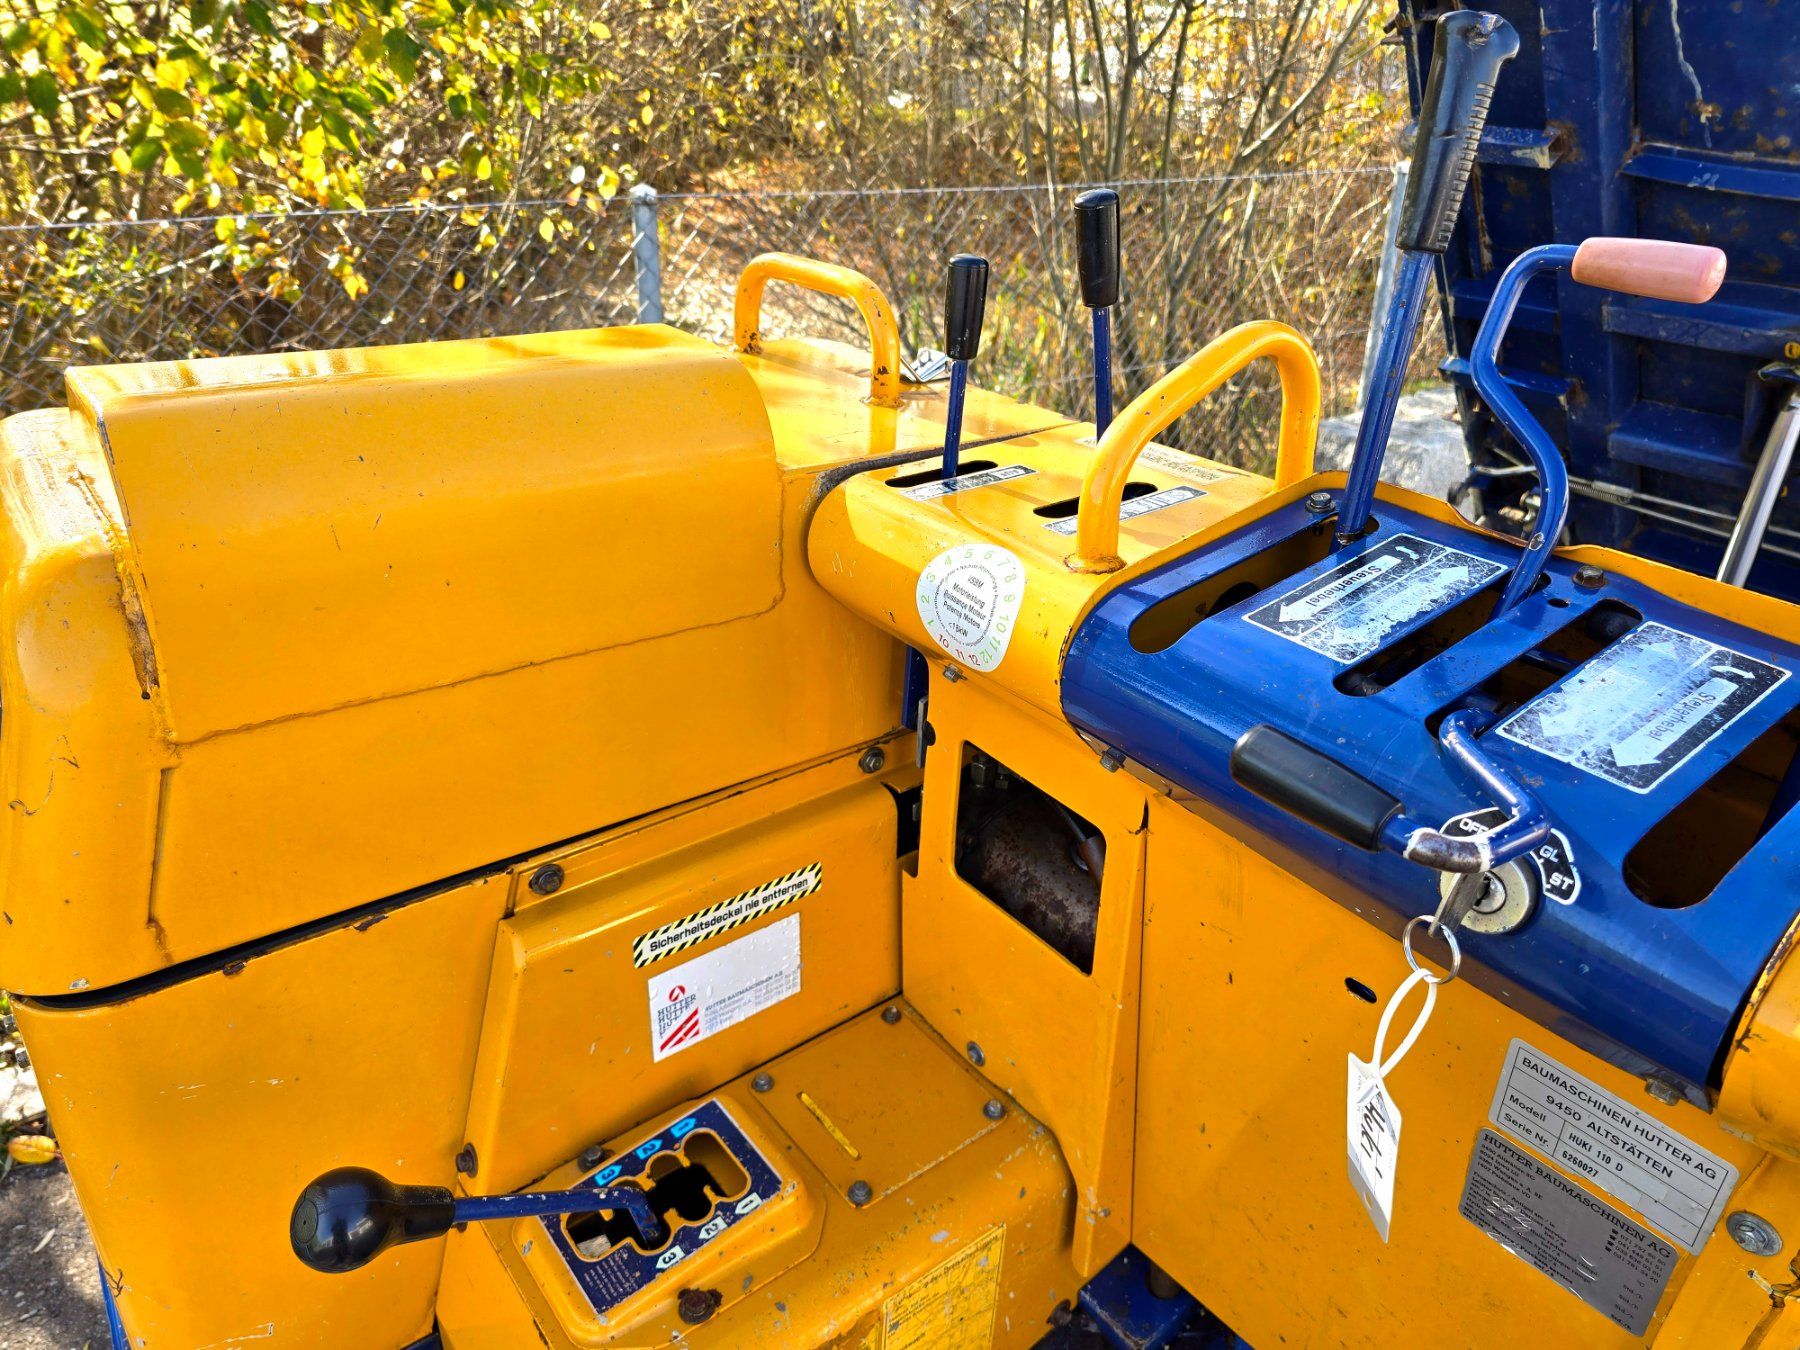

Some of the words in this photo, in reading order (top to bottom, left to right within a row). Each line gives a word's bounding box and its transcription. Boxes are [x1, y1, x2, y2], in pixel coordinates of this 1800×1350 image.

[945, 556, 952, 565] 4
[964, 549, 974, 558] 5
[984, 551, 995, 559] 6
[926, 573, 935, 582] 3
[1004, 575, 1017, 583] 8
[1305, 563, 1382, 608] Steuerhebel
[921, 595, 930, 604] 2
[1004, 594, 1015, 602] 9
[968, 605, 986, 620] Moteur
[996, 614, 1009, 633] 10
[939, 634, 949, 648] 10
[956, 648, 965, 660] 11
[969, 654, 981, 666] 12
[990, 636, 1001, 652] 11
[980, 648, 993, 664] 12
[1647, 692, 1716, 741] Steuerhebel
[1540, 845, 1559, 862] GL
[1550, 872, 1574, 889] ST
[650, 906, 743, 952] Sicherheitsdeckel
[745, 897, 759, 910] nie
[762, 878, 809, 903] entfernen
[658, 993, 696, 1016] HUTTER
[1521, 1056, 1632, 1129] BAUMASCHINEN
[1633, 1124, 1692, 1165] HUTTER
[1693, 1160, 1717, 1180] AG
[1508, 1093, 1546, 1123] Modell
[1568, 1131, 1592, 1153] HUKI
[1595, 1149, 1612, 1165] 110
[1615, 1161, 1624, 1173] D
[1544, 1093, 1582, 1122] 9450
[1586, 1117, 1674, 1179] ALTSTÄTTEN
[641, 1143, 659, 1155] 2
[1503, 1112, 1533, 1136] Serie
[1533, 1132, 1550, 1148] Nr.
[1561, 1149, 1598, 1179] 6260027
[600, 1169, 616, 1180] 3
[741, 1199, 754, 1209] 1
[1482, 1132, 1533, 1169] HUTTER
[1534, 1166, 1646, 1242] BAUMASCHINEN
[1647, 1239, 1671, 1260] AG
[706, 1222, 718, 1235] 2
[663, 1252, 677, 1264] 3
